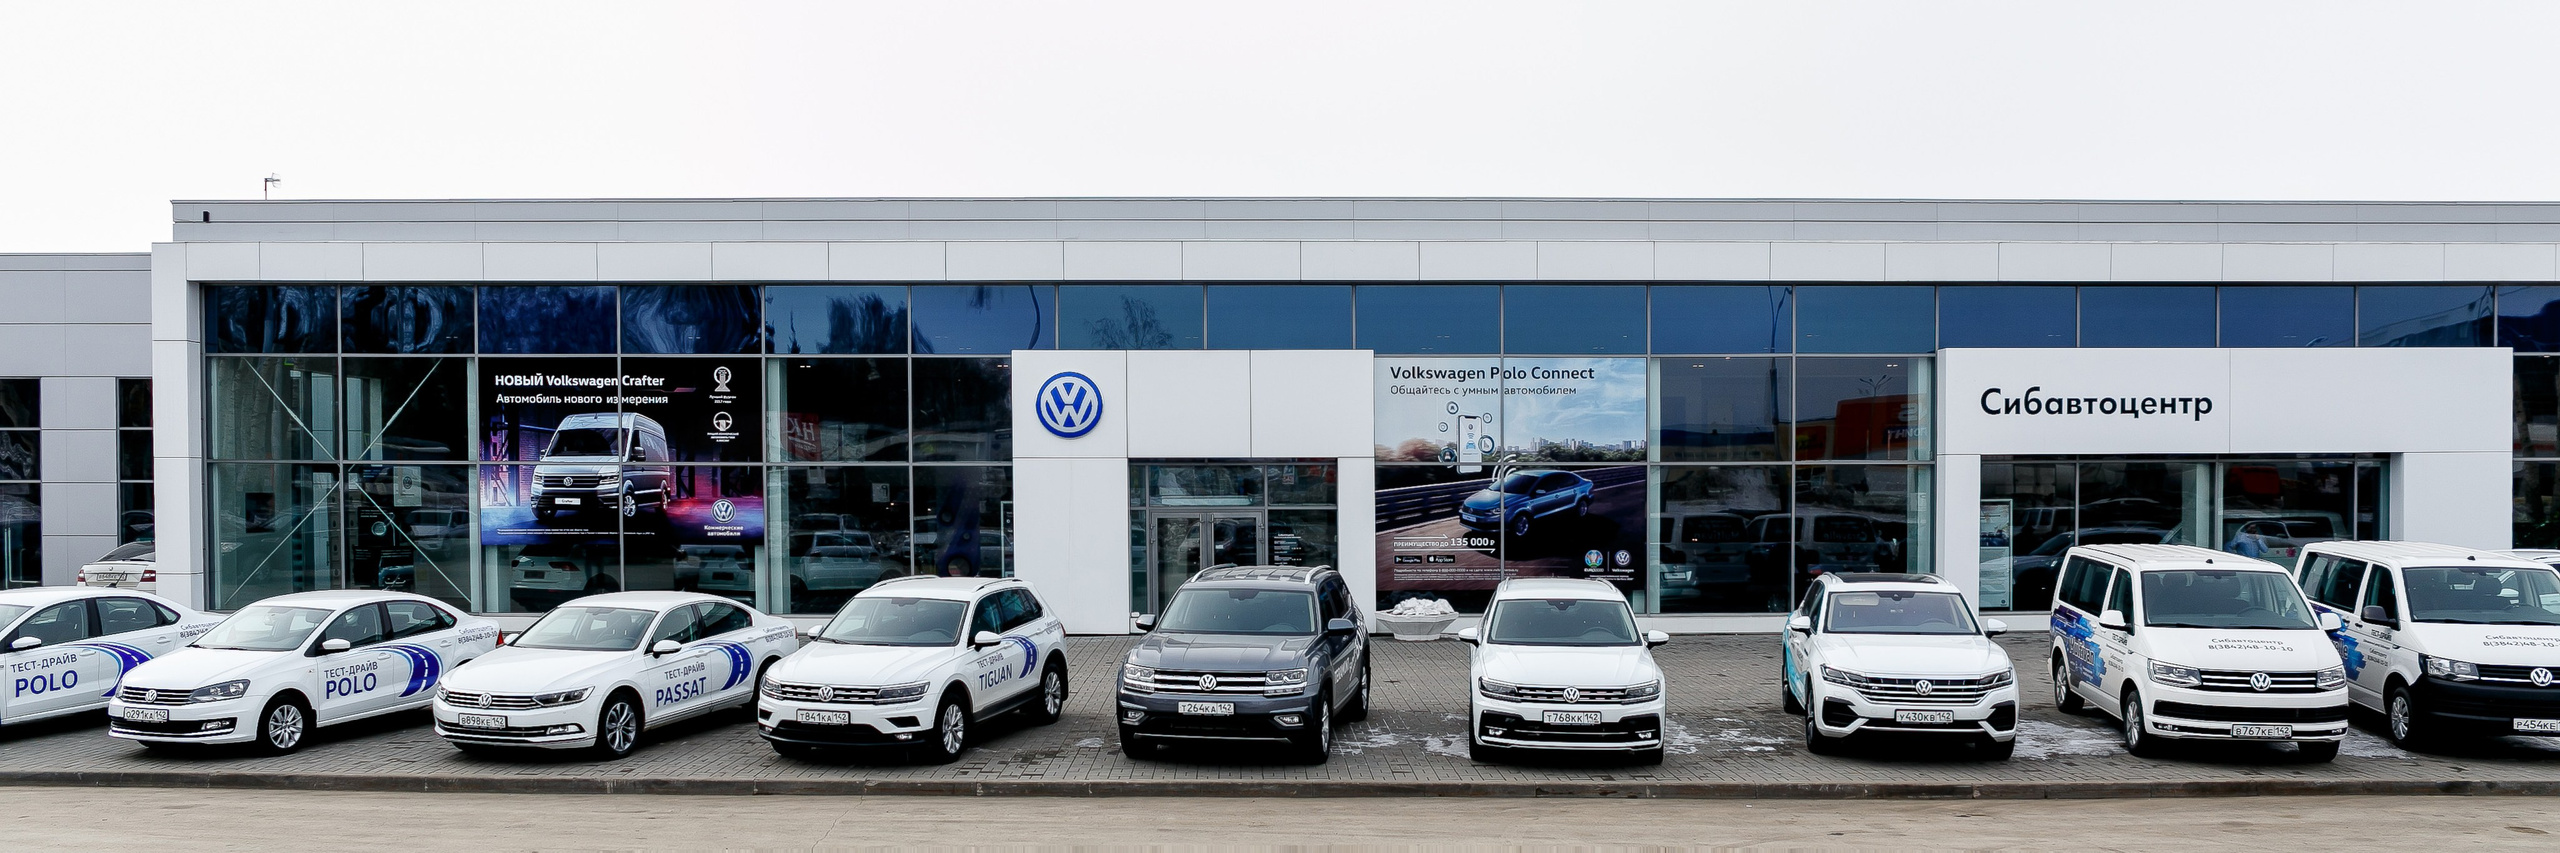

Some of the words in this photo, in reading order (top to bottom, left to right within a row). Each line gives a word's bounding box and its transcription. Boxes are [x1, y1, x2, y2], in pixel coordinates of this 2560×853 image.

[495, 372, 543, 386] НОВЫЙ
[546, 375, 619, 389] Volkswagen
[621, 375, 665, 386] Crafter
[1390, 366, 1485, 382] Volkswagen
[1490, 366, 1527, 379] Polo
[1531, 366, 1595, 379] Connect
[496, 393, 562, 404] Автомобиль
[564, 395, 603, 404] нового
[1390, 385, 1451, 395] Общайтесь
[1453, 387, 1459, 395] с
[1462, 387, 1498, 397] умным
[1504, 385, 1577, 395] автомобилем
[1980, 386, 2213, 421] Сибавтоцентр
[1450, 538, 1468, 546] 135
[1470, 538, 1489, 546] 000
[181, 621, 220, 631] Сибавтоцент
[2208, 644, 2294, 652] 8(3842)48-10-10
[10, 653, 78, 673] ТЕСТ-ДРАЙВ
[324, 660, 378, 679] ТЕСТ-ДРАЙВ
[664, 661, 706, 680] ТЕСТ-ДРАЙВ
[15, 670, 78, 698] POLO
[979, 663, 1013, 691] TIGUAN
[326, 672, 377, 699] POLO
[656, 676, 707, 707] PASSAT
[833, 713, 847, 721] 142
[1584, 713, 1599, 721] 142
[1937, 712, 1951, 720] 142
[2275, 726, 2290, 734] 142
